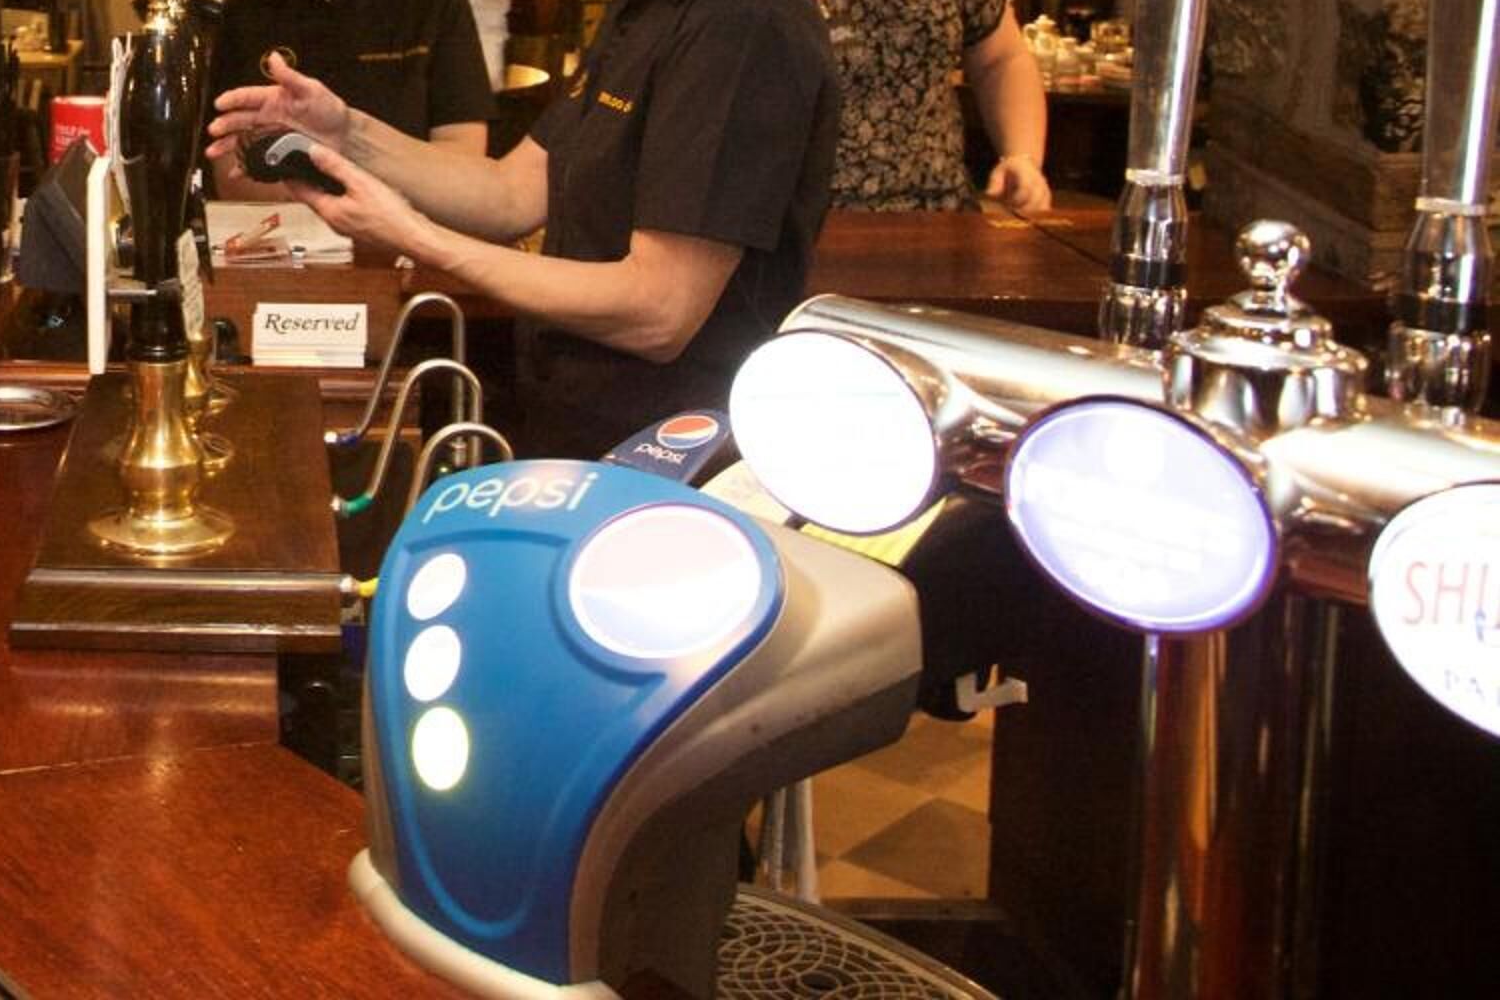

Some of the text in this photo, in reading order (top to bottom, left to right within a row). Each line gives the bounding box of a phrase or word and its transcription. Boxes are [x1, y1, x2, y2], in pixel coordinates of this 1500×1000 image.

[264, 312, 360, 335] Reserved
[633, 442, 688, 465] pepsi
[422, 472, 598, 524] pepsi
[1403, 560, 1500, 627] SHI
